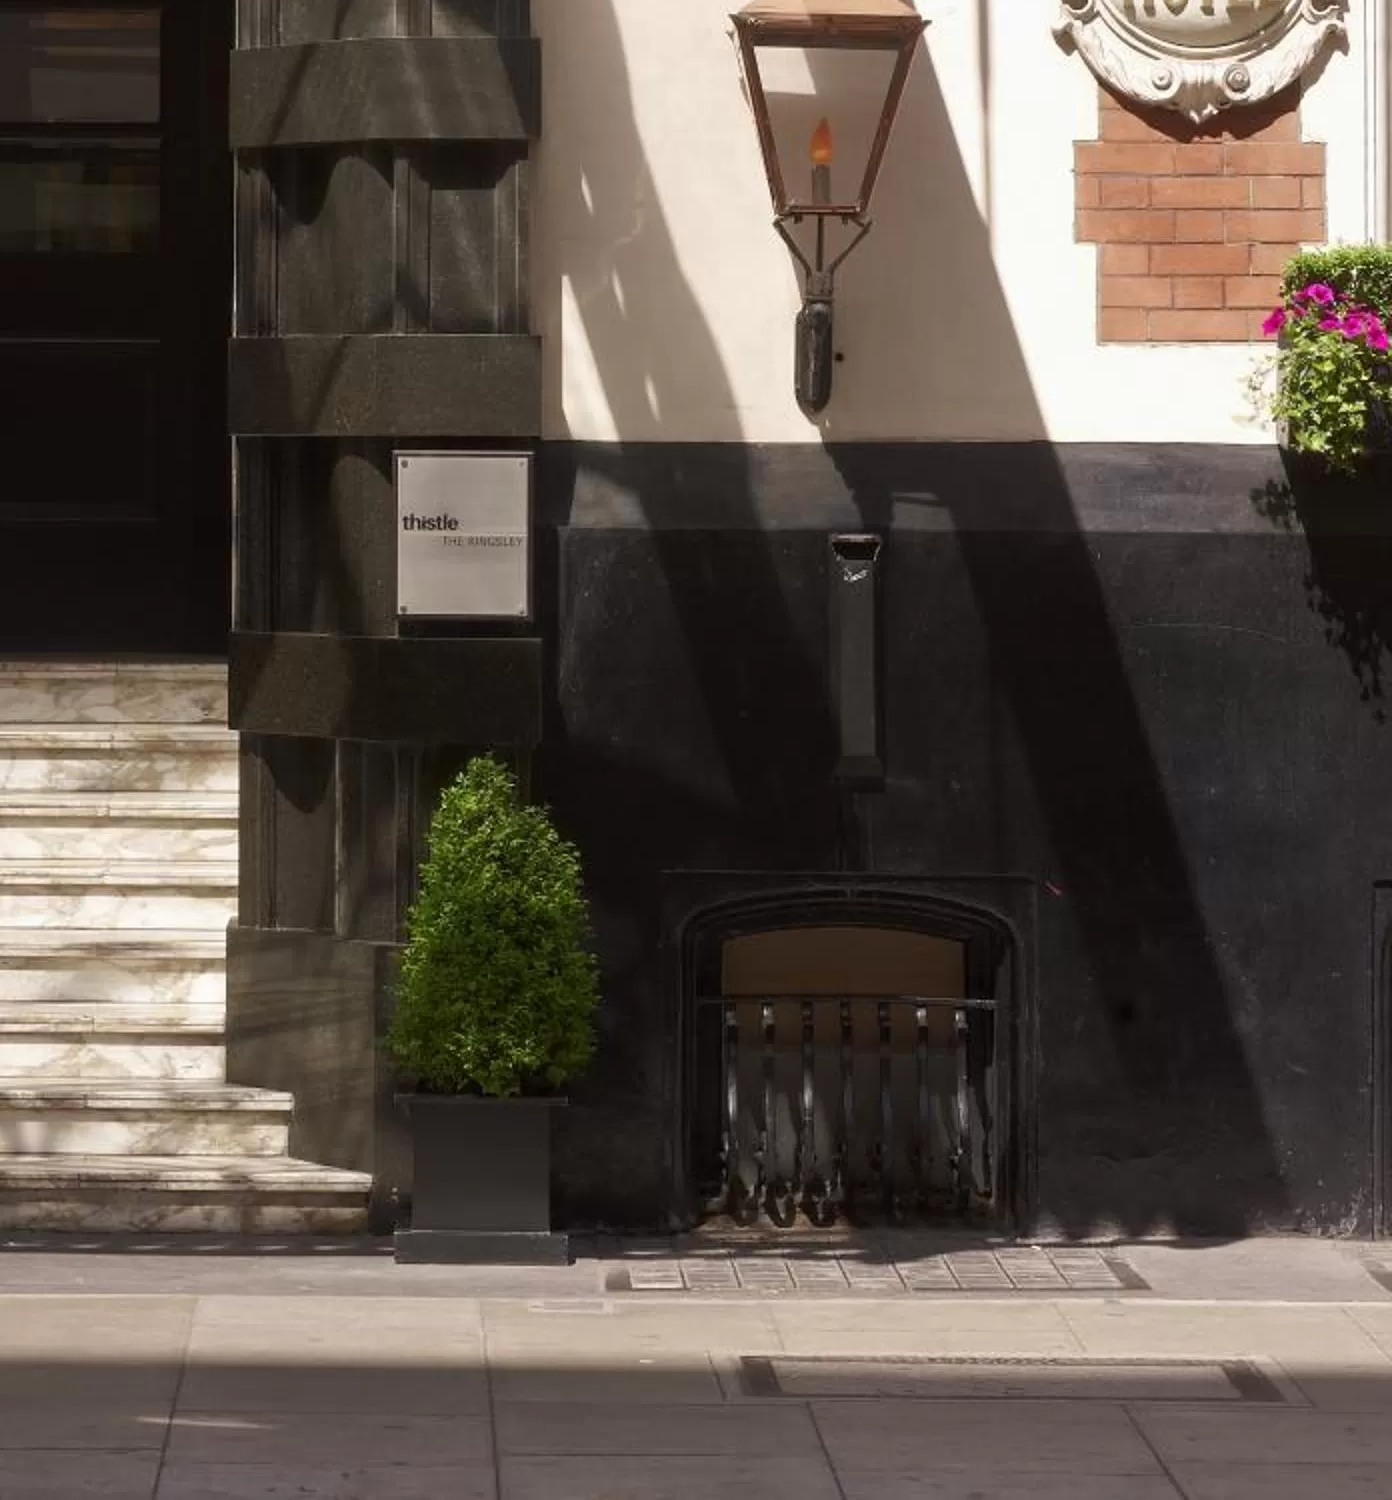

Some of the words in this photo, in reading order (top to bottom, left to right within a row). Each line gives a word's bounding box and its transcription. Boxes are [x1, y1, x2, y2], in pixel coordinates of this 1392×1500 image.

[402, 513, 459, 531] thistle
[442, 535, 463, 547] THE
[467, 535, 523, 547] KINGSLEY
